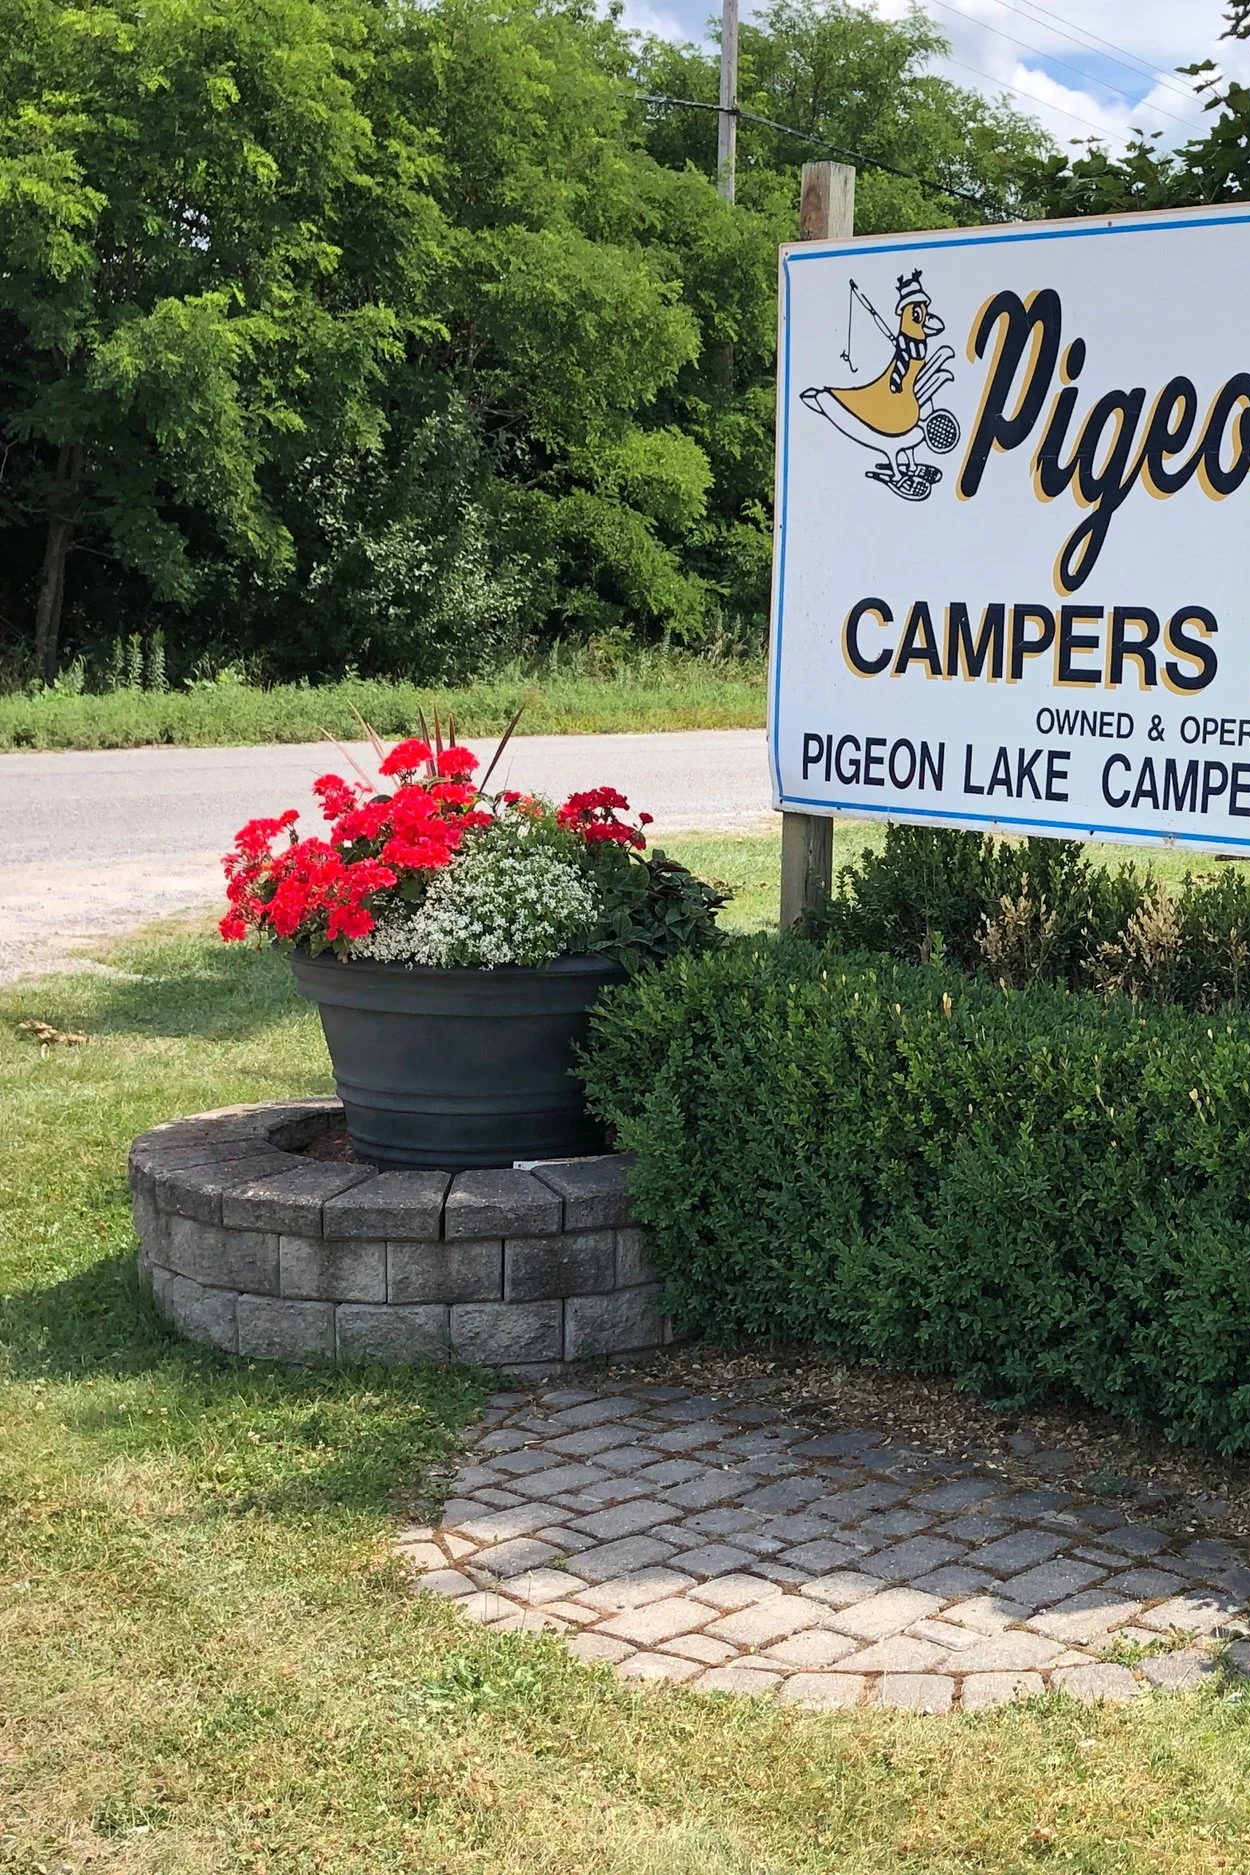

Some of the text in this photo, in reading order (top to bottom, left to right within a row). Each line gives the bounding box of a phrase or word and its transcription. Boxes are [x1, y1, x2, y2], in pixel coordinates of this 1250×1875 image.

[842, 597, 1220, 696] CAMPERS
[1035, 707, 1135, 740] OWNED
[1147, 714, 1166, 742] &
[801, 732, 946, 792] PIGEON
[962, 743, 1072, 803] LAKE
